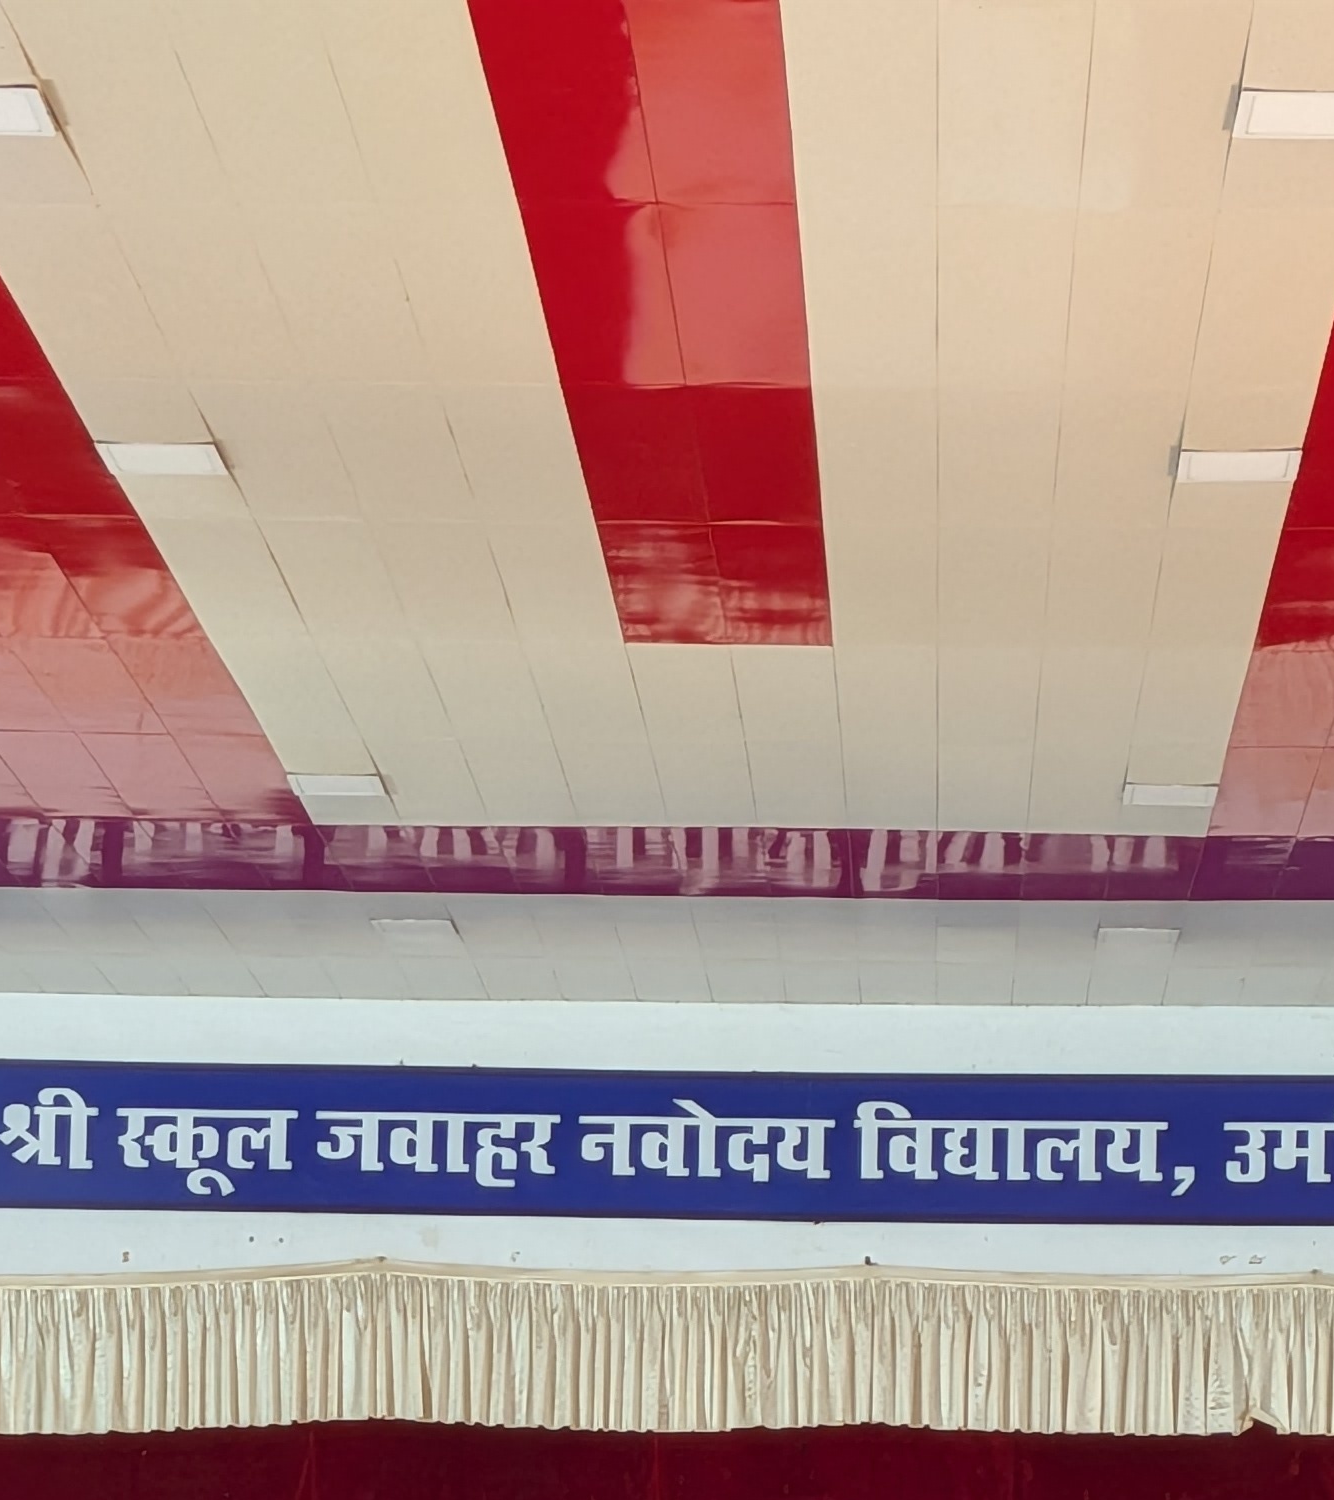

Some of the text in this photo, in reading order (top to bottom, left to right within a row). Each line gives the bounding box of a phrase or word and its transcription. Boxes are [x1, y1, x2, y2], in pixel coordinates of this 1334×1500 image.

[117, 1107, 298, 1196] स्कूल
[316, 1110, 560, 1188] जवाहर
[579, 1098, 835, 1183] नवोदय
[854, 1101, 1194, 1196] विद्यालय,
